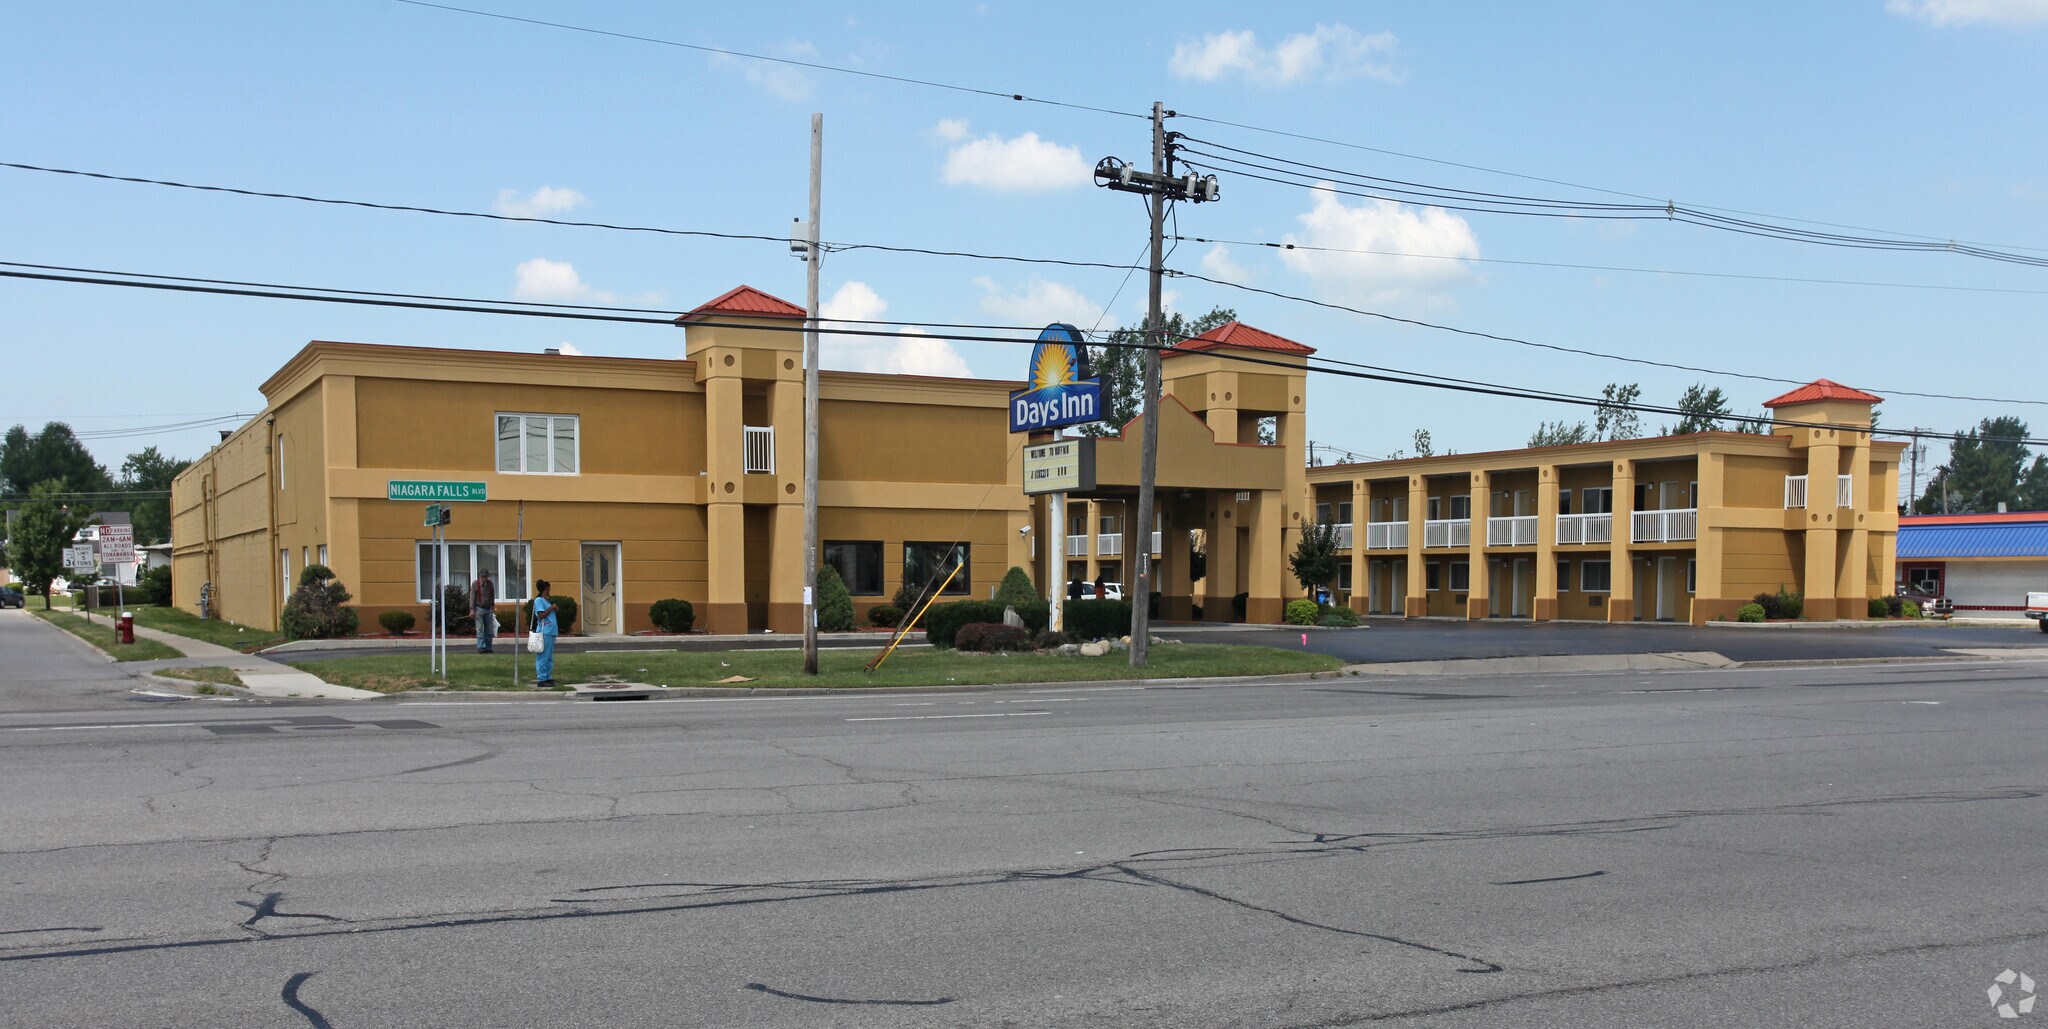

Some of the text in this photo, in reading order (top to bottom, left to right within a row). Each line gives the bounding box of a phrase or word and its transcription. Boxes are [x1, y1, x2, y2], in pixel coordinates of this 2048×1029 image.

[1017, 392, 1093, 426] Days Inn
[390, 484, 435, 496] NIAGARA
[437, 485, 469, 496] FALLS
